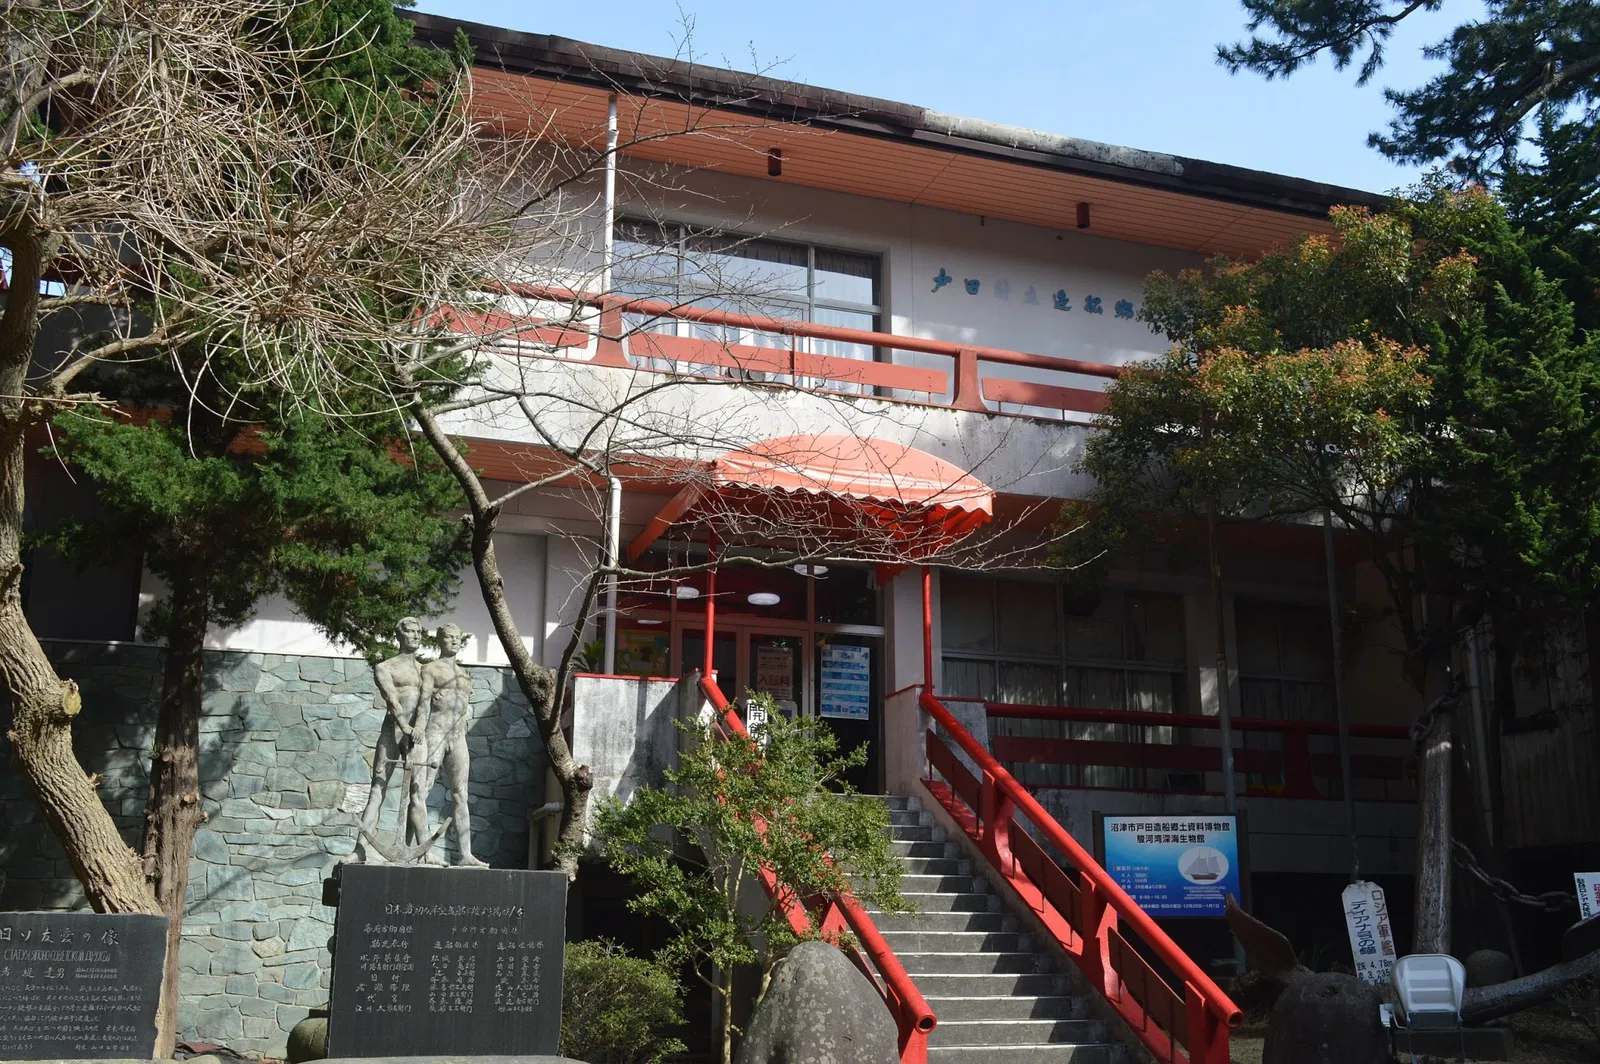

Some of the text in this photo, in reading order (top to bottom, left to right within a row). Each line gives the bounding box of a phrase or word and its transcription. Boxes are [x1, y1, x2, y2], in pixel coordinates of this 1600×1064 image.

[1110, 822, 1231, 832] 沼津市戸田造船郷土資料博物館
[1136, 834, 1206, 844] 駿河湾深海生物館
[1350, 899, 1377, 956] ディアナ号の錨
[1371, 889, 1394, 956] ロシア軍艦
